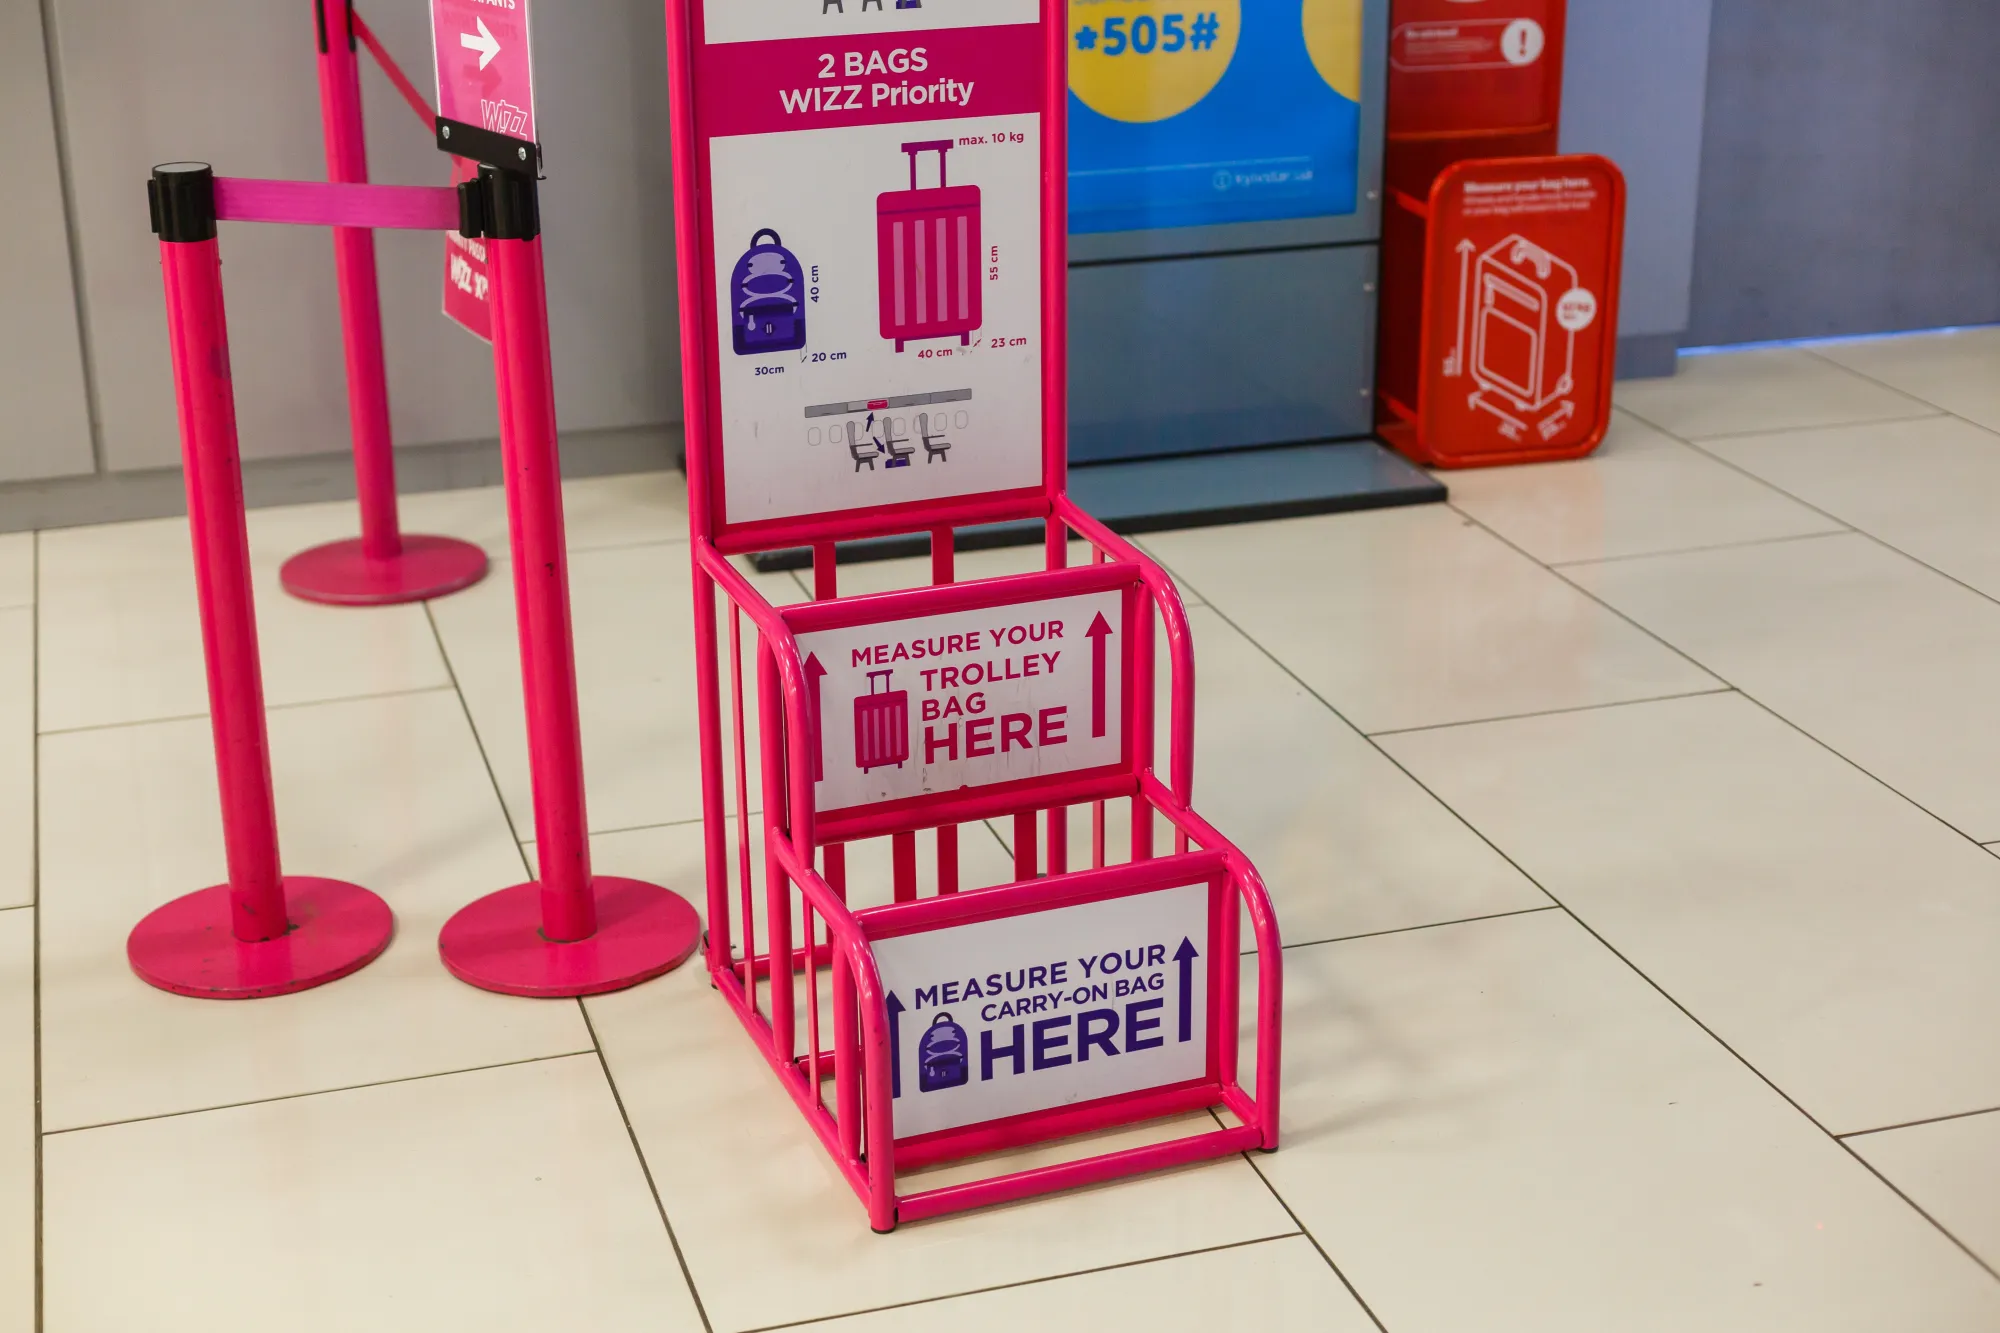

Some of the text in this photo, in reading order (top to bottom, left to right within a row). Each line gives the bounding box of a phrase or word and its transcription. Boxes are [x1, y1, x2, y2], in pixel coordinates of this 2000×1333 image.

[818, 47, 929, 79] 2 BAGS
[779, 77, 974, 114] WIZZ Priority
[958, 131, 1025, 147] max. 10 kg
[989, 245, 999, 281] 55 cm
[810, 265, 820, 303] 40 cm
[811, 350, 847, 363] 20 cm
[917, 348, 953, 359] 40 cm
[991, 336, 1027, 349] 23 cm
[754, 365, 785, 376] 30cm
[852, 620, 1064, 668] MEASURE YOUR
[920, 651, 1061, 692] TROLLEY
[921, 692, 986, 722] BAG
[924, 705, 1068, 765] HERE
[915, 943, 1166, 1010] MEASURE YOUR
[981, 972, 1164, 1022] CARRY-ON BAG
[980, 997, 1164, 1082] HERE
